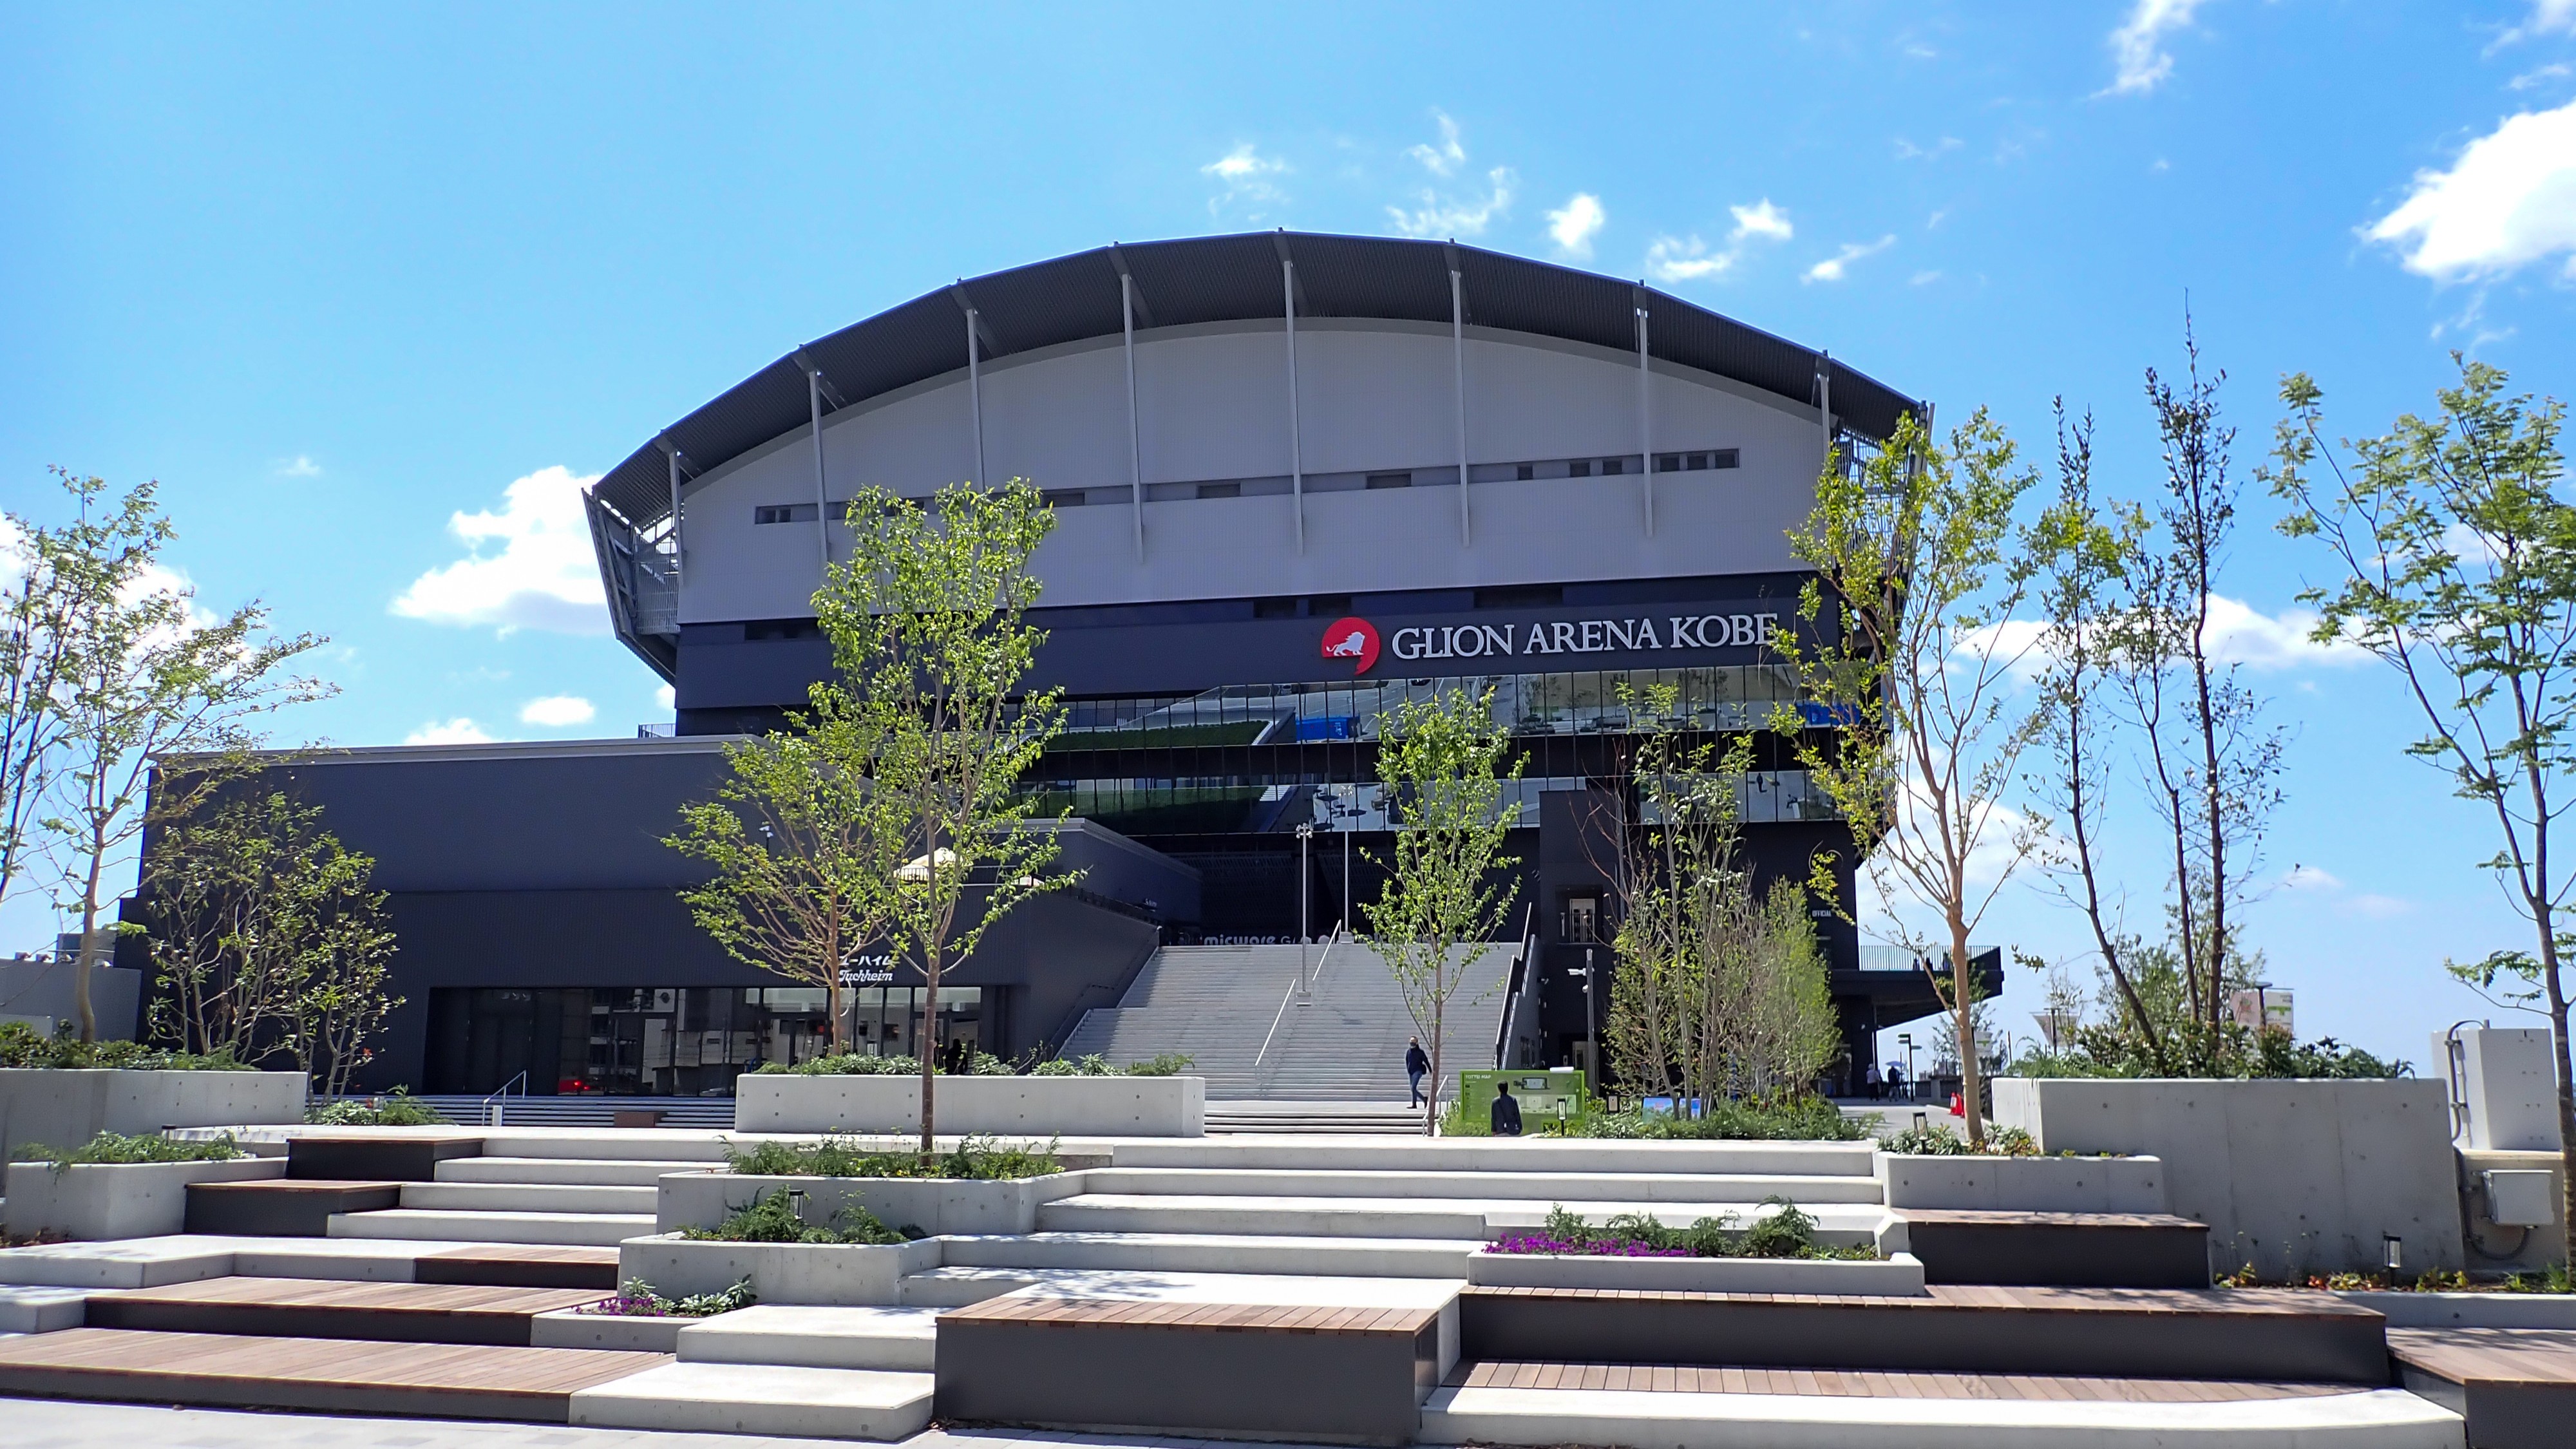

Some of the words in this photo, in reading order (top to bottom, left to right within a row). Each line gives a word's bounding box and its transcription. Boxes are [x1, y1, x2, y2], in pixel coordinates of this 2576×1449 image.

[1392, 625, 1515, 659] GLION
[1523, 618, 1662, 654] ARENA
[1669, 613, 1777, 649] KOBE
[1204, 934, 1276, 945] micware
